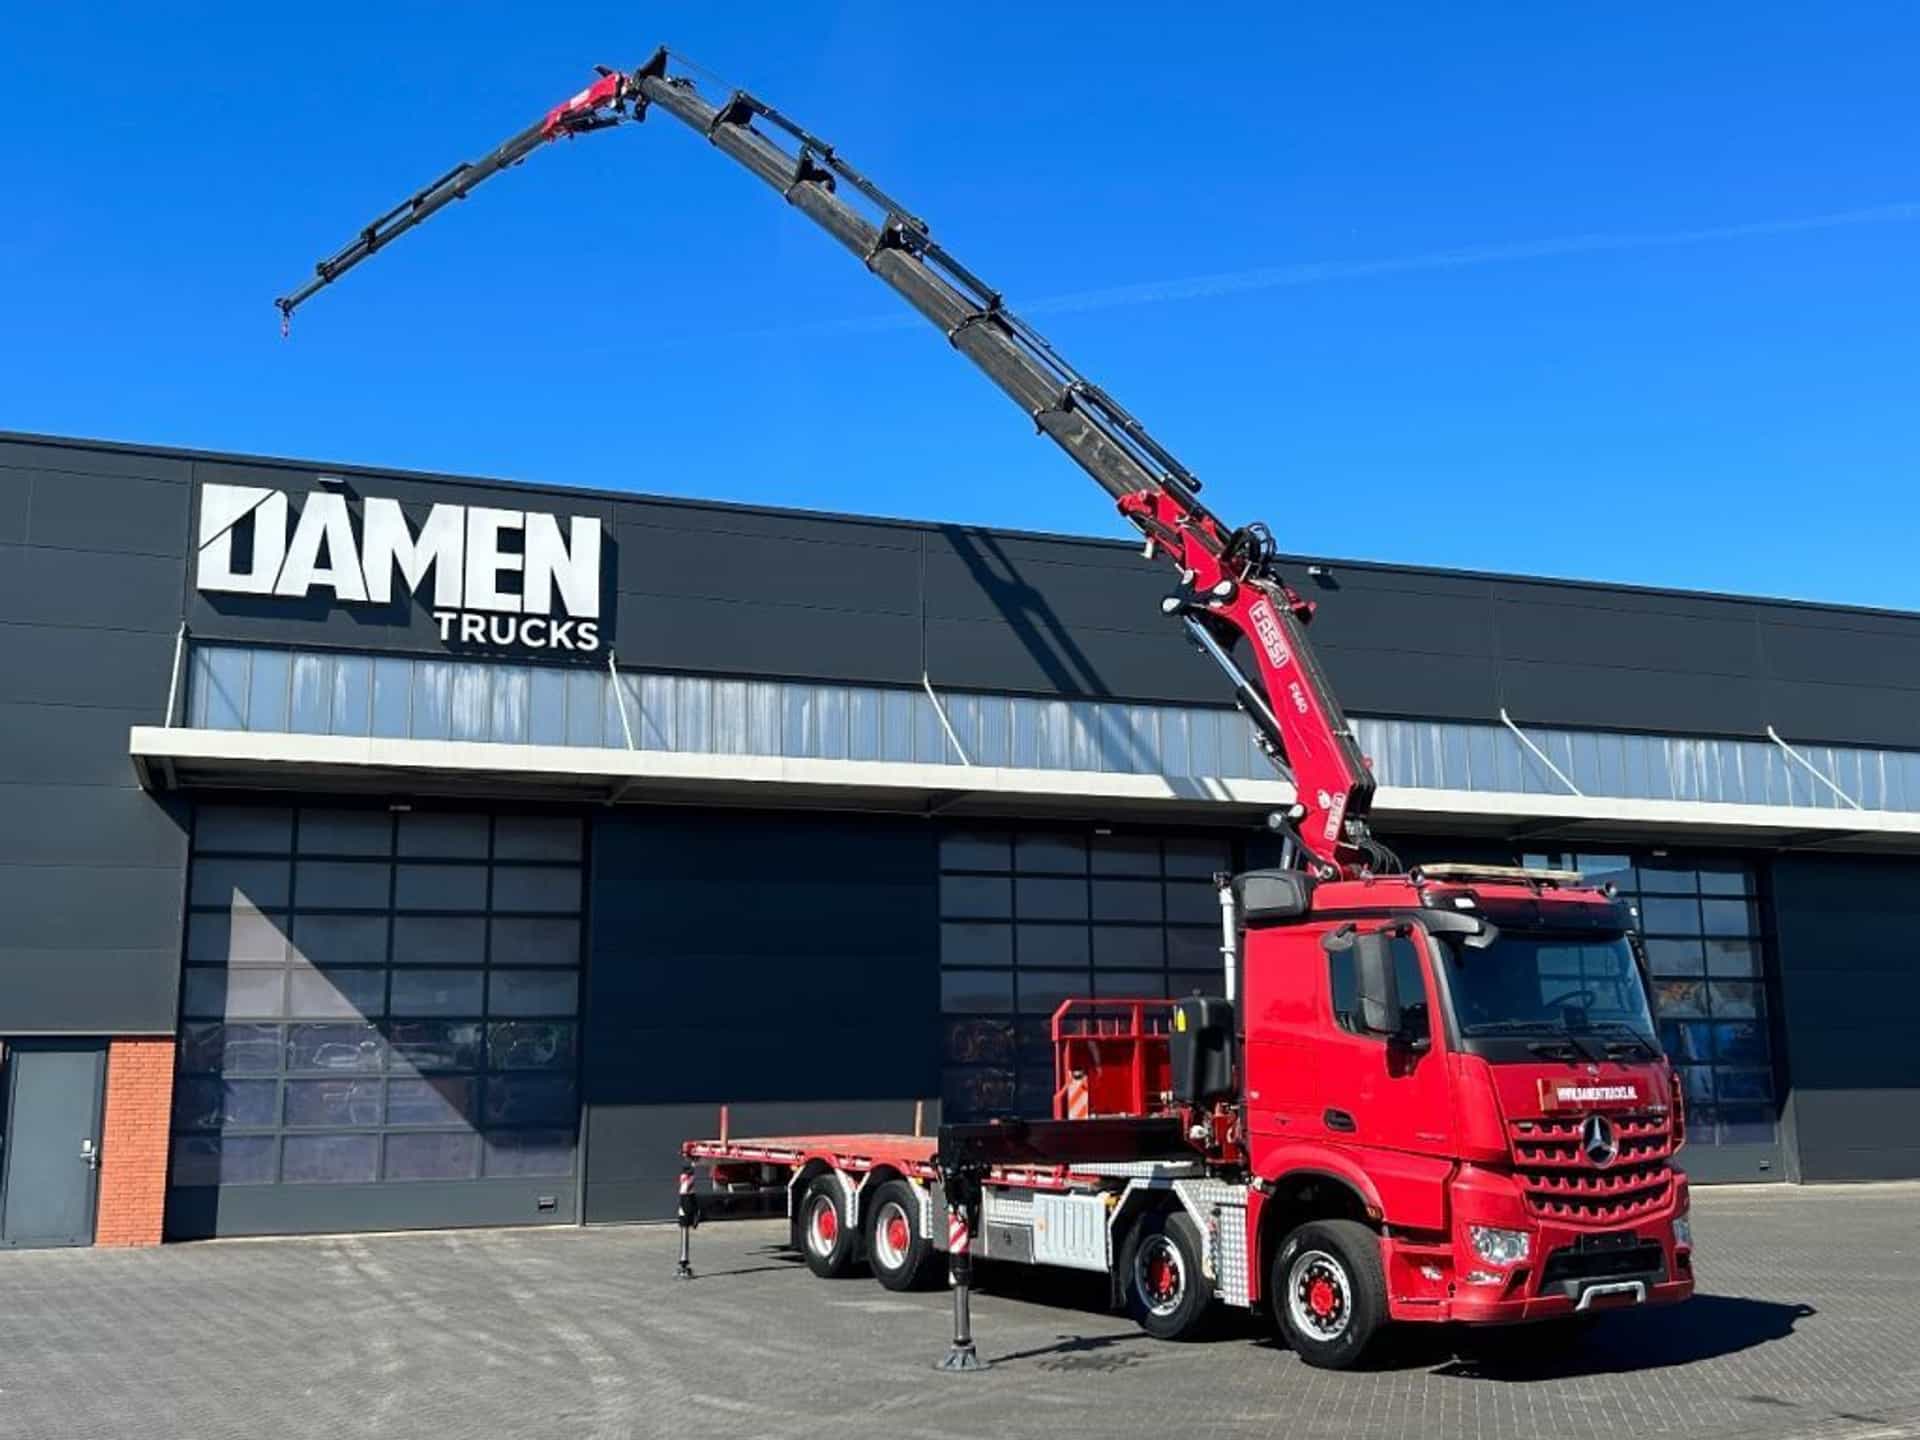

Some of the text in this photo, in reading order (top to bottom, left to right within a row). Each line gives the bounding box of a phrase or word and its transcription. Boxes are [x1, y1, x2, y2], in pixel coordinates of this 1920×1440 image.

[197, 483, 601, 618] DAMEN
[434, 611, 600, 651] TRUCKS
[1251, 602, 1288, 667] FASSI
